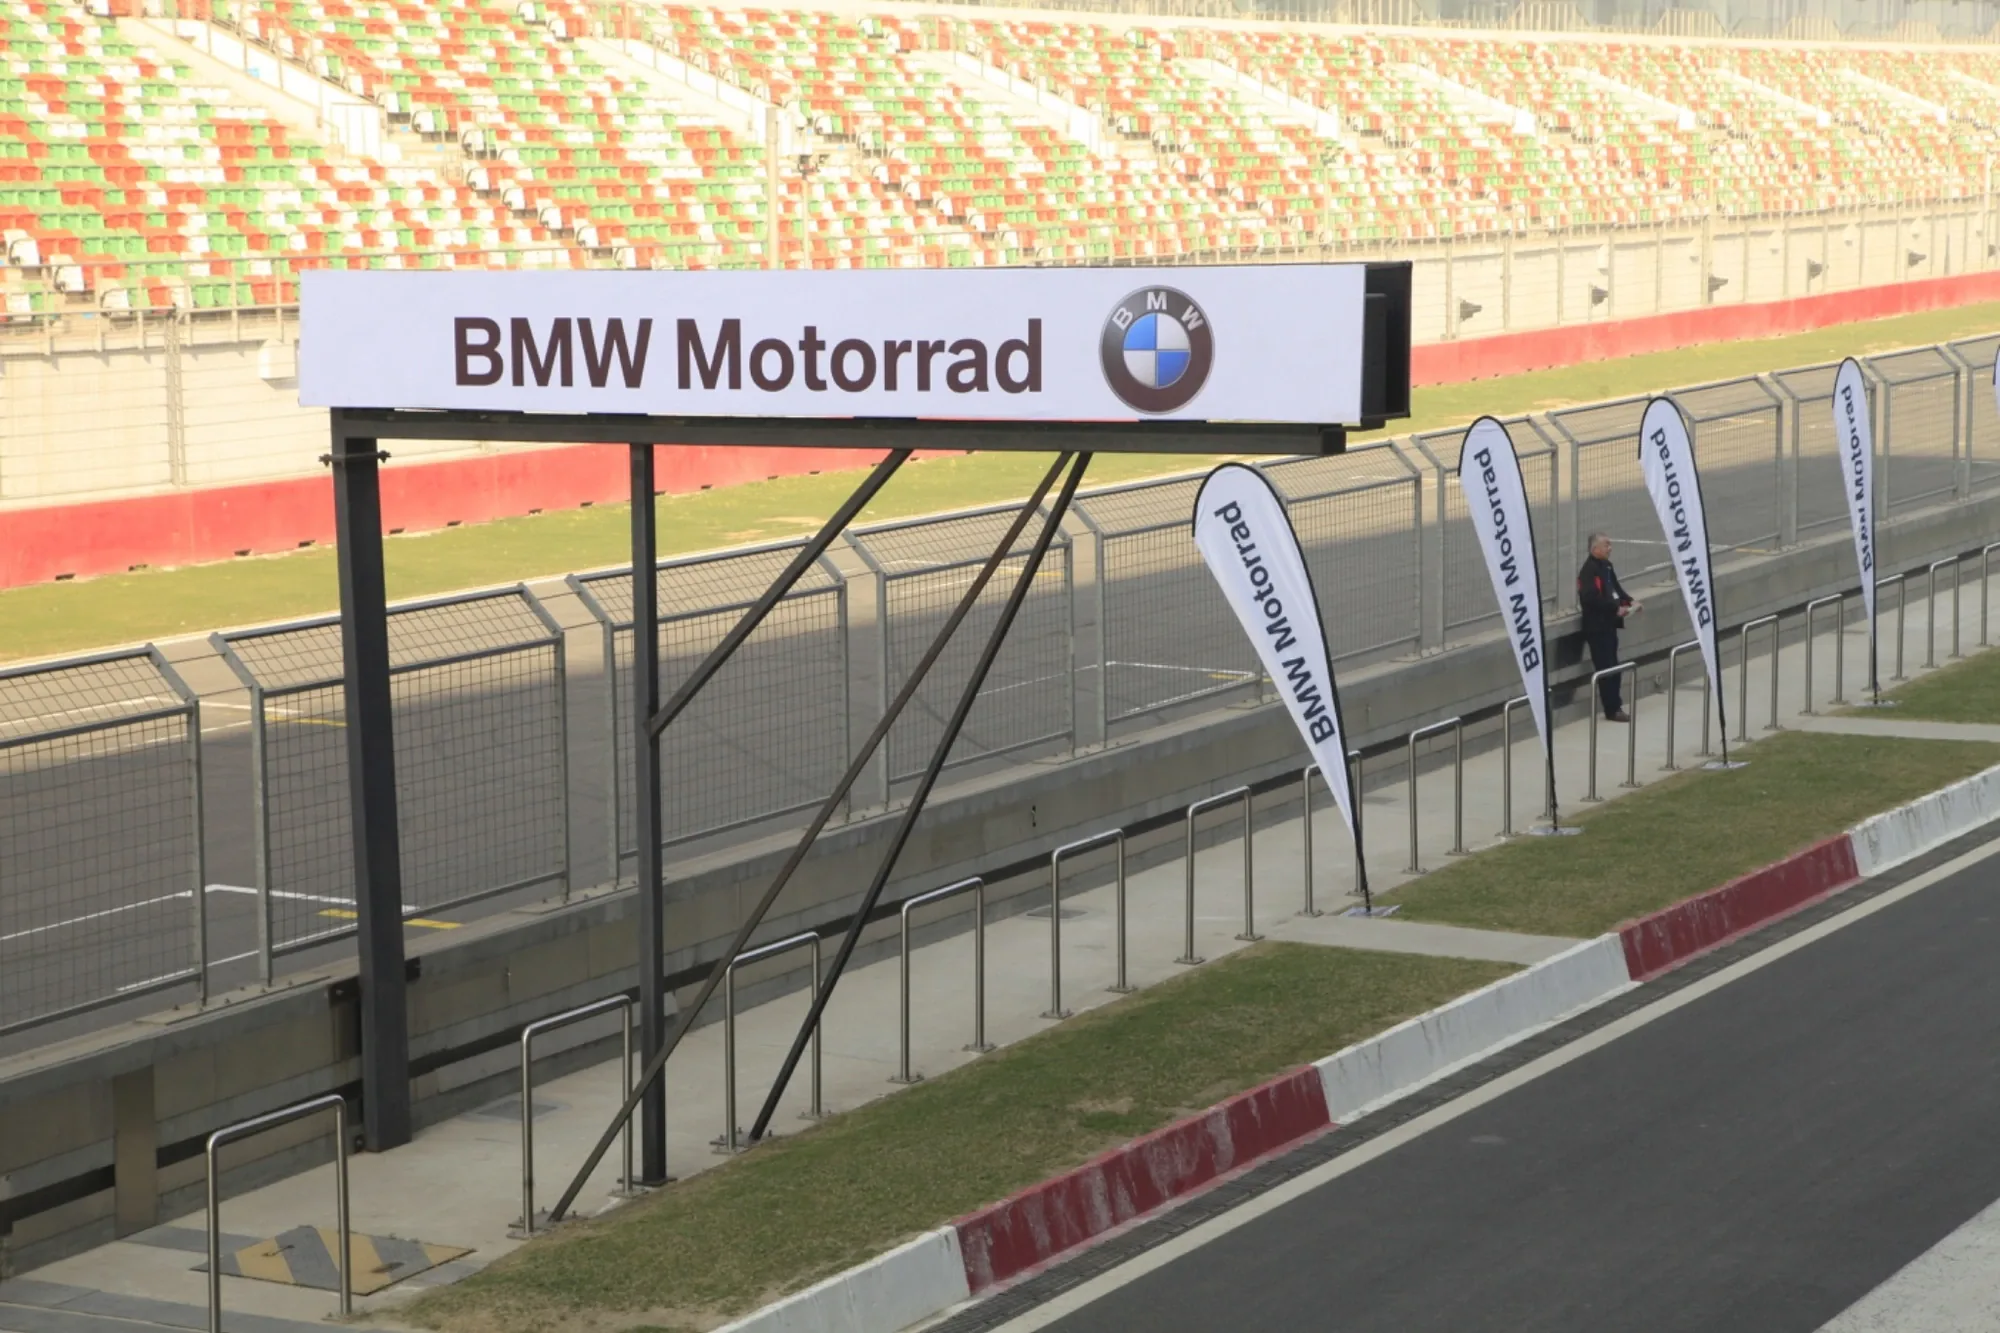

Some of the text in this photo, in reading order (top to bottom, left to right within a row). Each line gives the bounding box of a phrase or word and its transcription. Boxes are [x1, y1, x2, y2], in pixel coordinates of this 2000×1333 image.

[454, 316, 1042, 393] BMW Motorrad
[1111, 290, 1204, 331] BMW
[1214, 500, 1336, 744] BMW Motorrad
[1474, 447, 1540, 673] BMW Motorrad
[1650, 428, 1712, 629] BMW Motorrad
